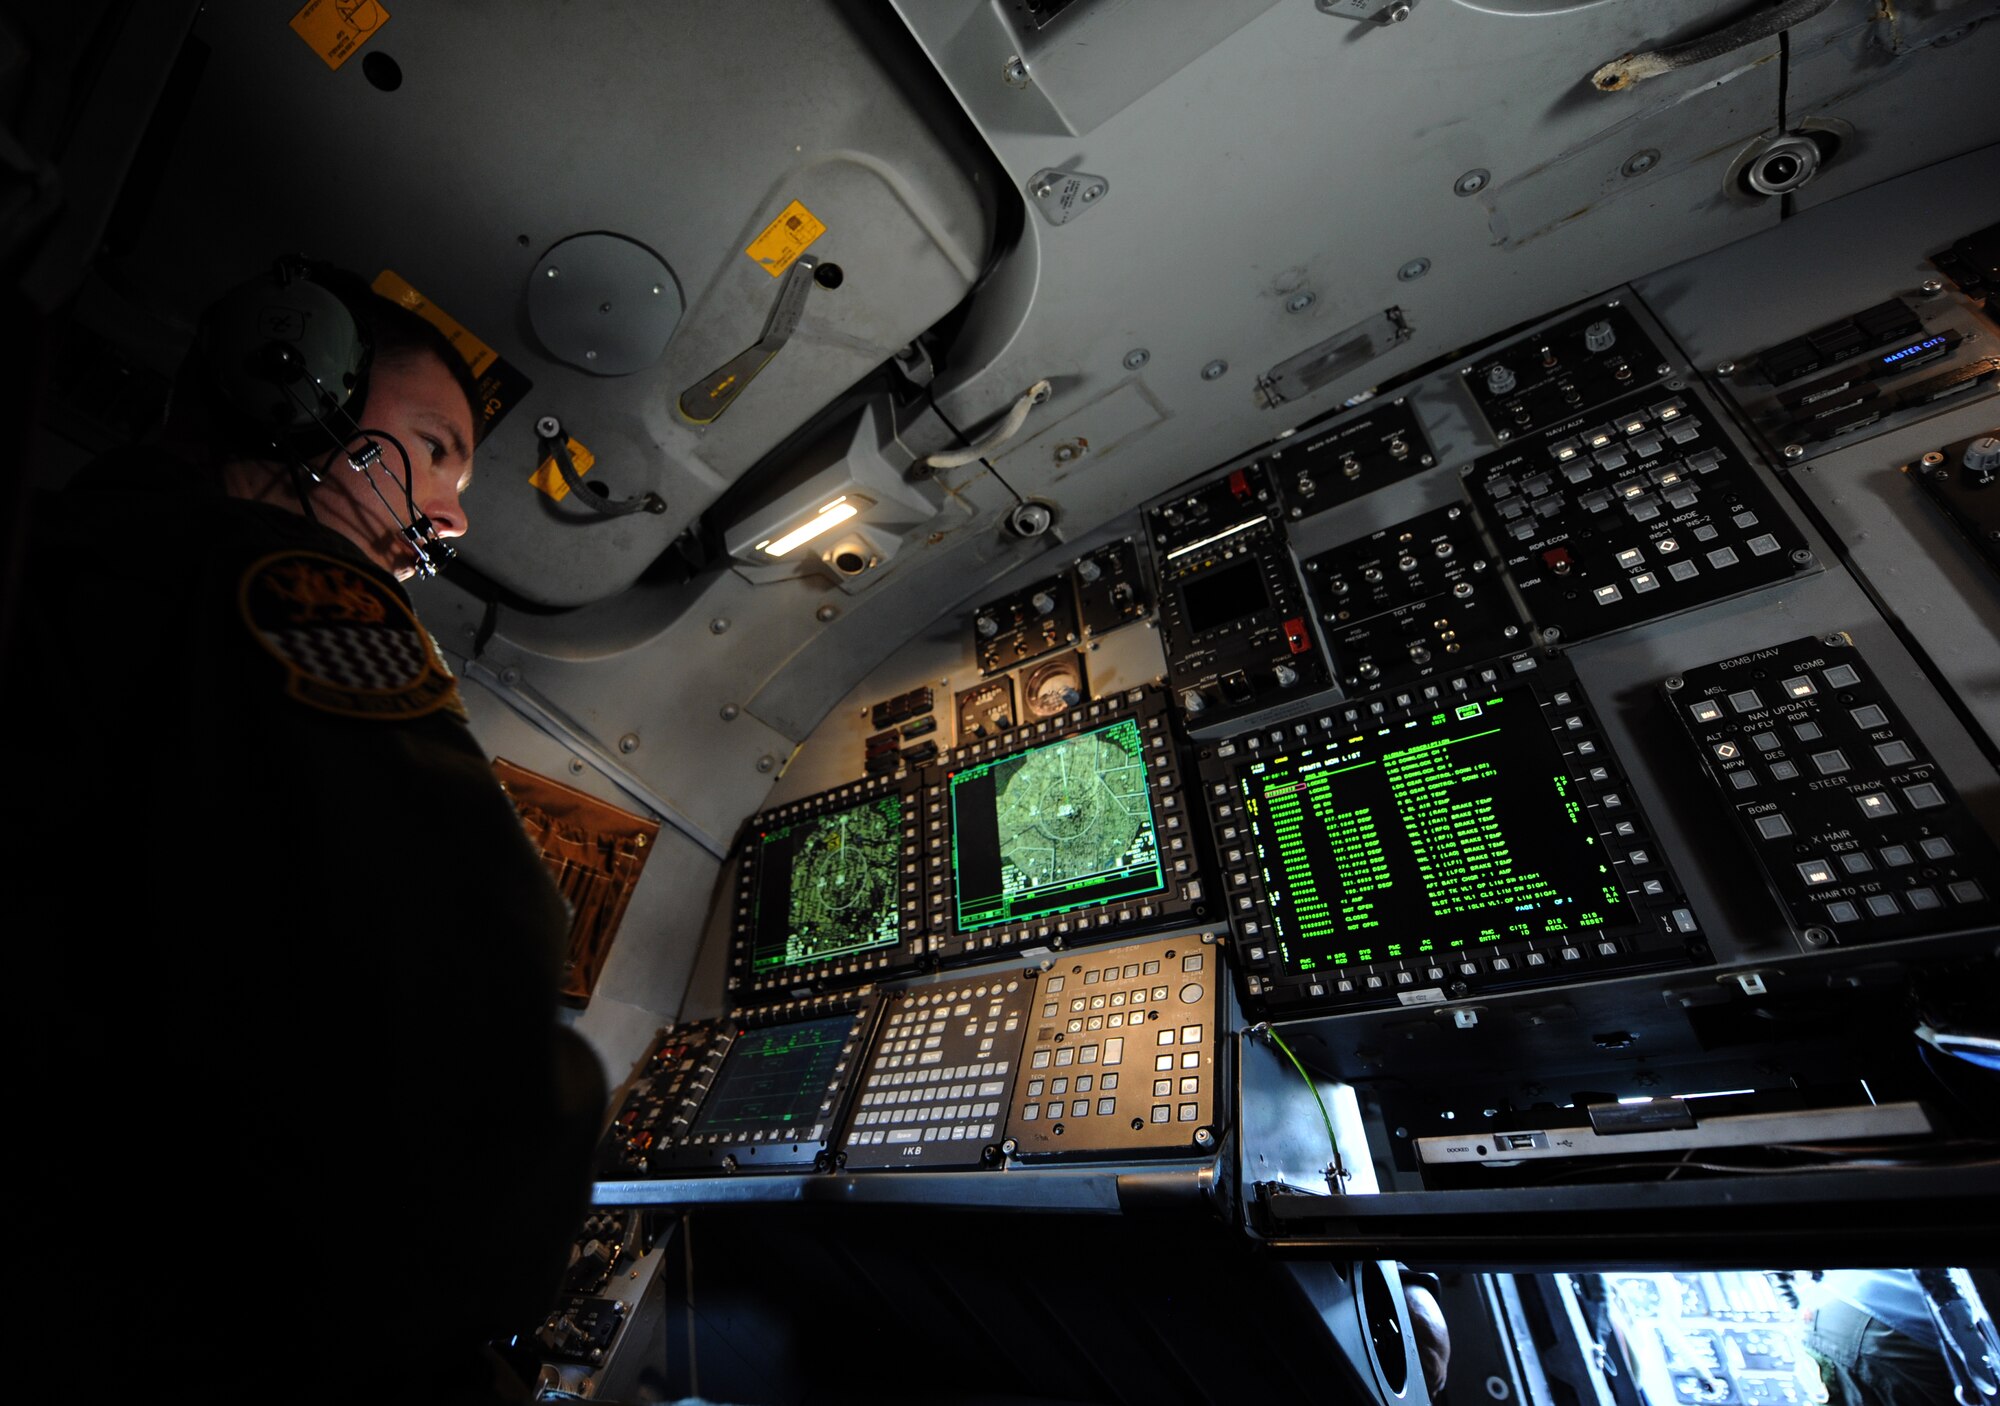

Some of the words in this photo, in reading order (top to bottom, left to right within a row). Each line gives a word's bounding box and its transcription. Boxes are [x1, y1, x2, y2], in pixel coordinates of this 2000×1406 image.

[1883, 345, 1922, 364] MASTER
[1922, 336, 1946, 350] CITS
[1619, 468, 1636, 478] NAV
[1638, 460, 1659, 470] PWR
[1979, 474, 1995, 484] OFF
[1731, 504, 1744, 512] DR
[1650, 520, 1669, 530] NAV
[1672, 510, 1699, 524] MODE
[1686, 515, 1711, 528] INS-2
[1720, 648, 1779, 670] BOMB/NAV
[1794, 658, 1825, 672] BOMB
[1704, 686, 1727, 696] MSL
[1748, 710, 1770, 721] NAV
[1773, 699, 1817, 715] UPDATE
[1787, 711, 1809, 722] RDR
[1758, 719, 1775, 729] FLY
[1706, 732, 1723, 742] ALT
[1872, 730, 1893, 740] REJ
[1342, 752, 1360, 762] LIST
[1764, 751, 1786, 761] DES
[1722, 760, 1745, 771] MPW
[1890, 774, 1910, 784] FLY
[1912, 770, 1929, 779] TO
[1809, 776, 1848, 791] STEER
[1845, 780, 1884, 793] TRACK
[1747, 802, 1777, 815] BOMB
[1823, 829, 1851, 842] HAIR
[1830, 840, 1860, 852] DEST
[1817, 888, 1840, 899] HAIR
[1841, 886, 1856, 896] TO
[1860, 882, 1883, 893] TGT
[1580, 918, 1603, 926] RESET
[1479, 934, 1500, 942] ENTRY
[903, 1146, 922, 1155] IKB
